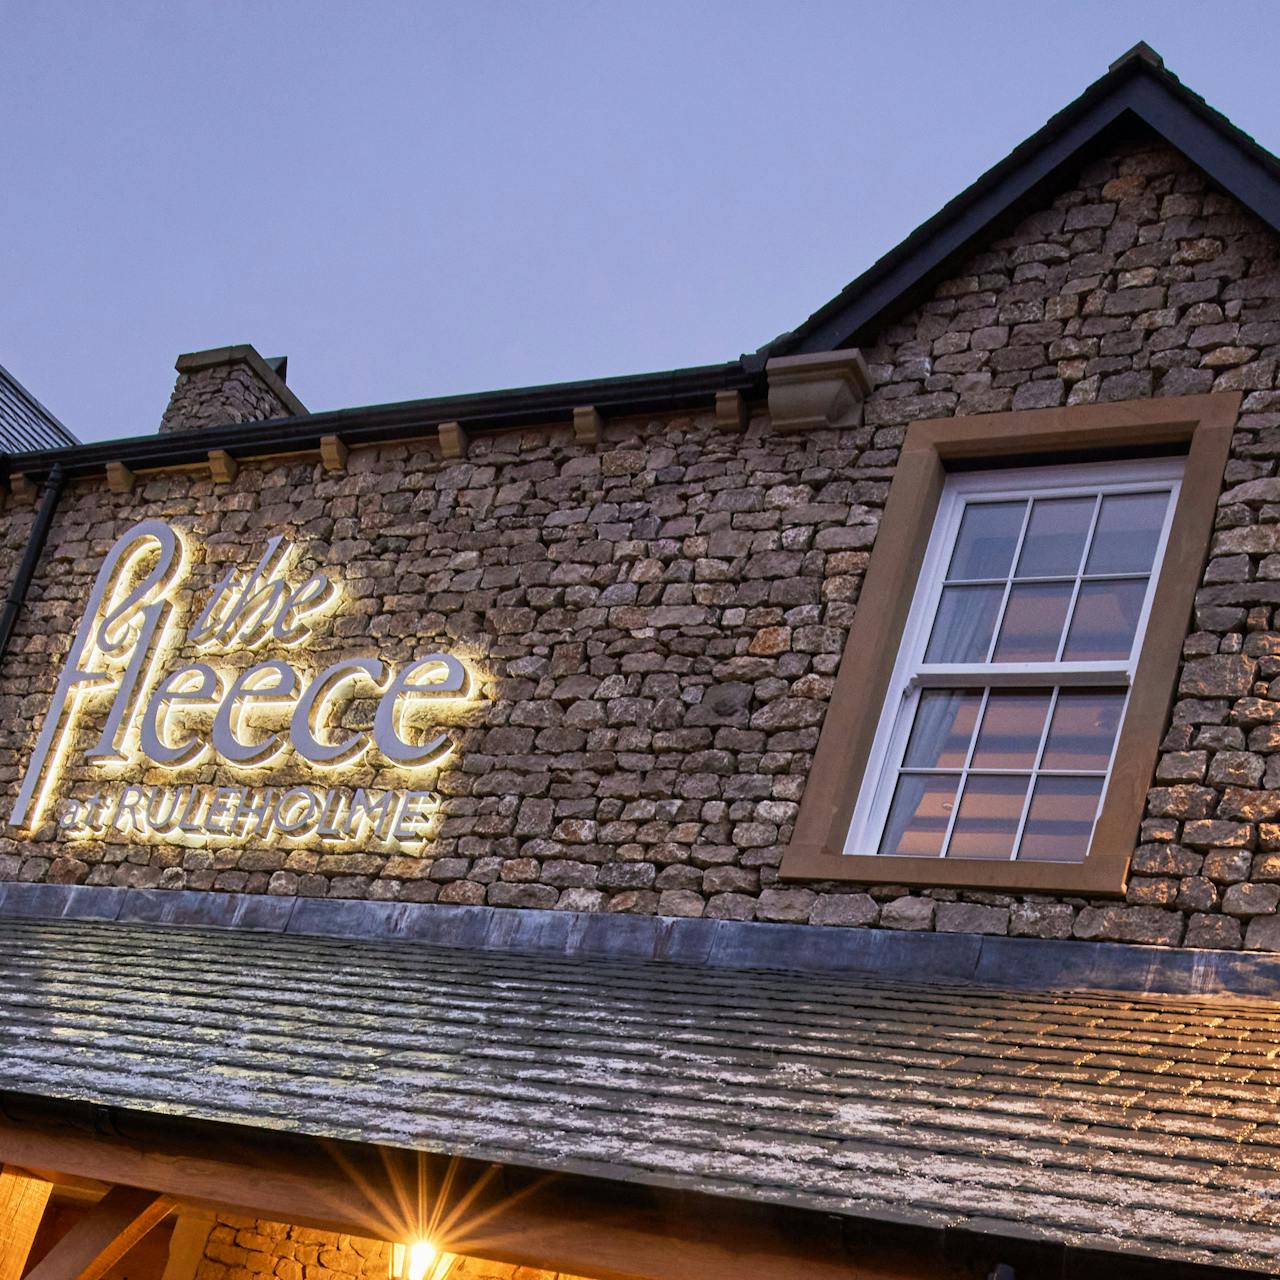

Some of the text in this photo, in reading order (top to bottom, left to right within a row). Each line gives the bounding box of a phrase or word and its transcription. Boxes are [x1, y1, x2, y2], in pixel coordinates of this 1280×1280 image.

[189, 535, 328, 647] the
[59, 785, 432, 838] at RULEHOLME
